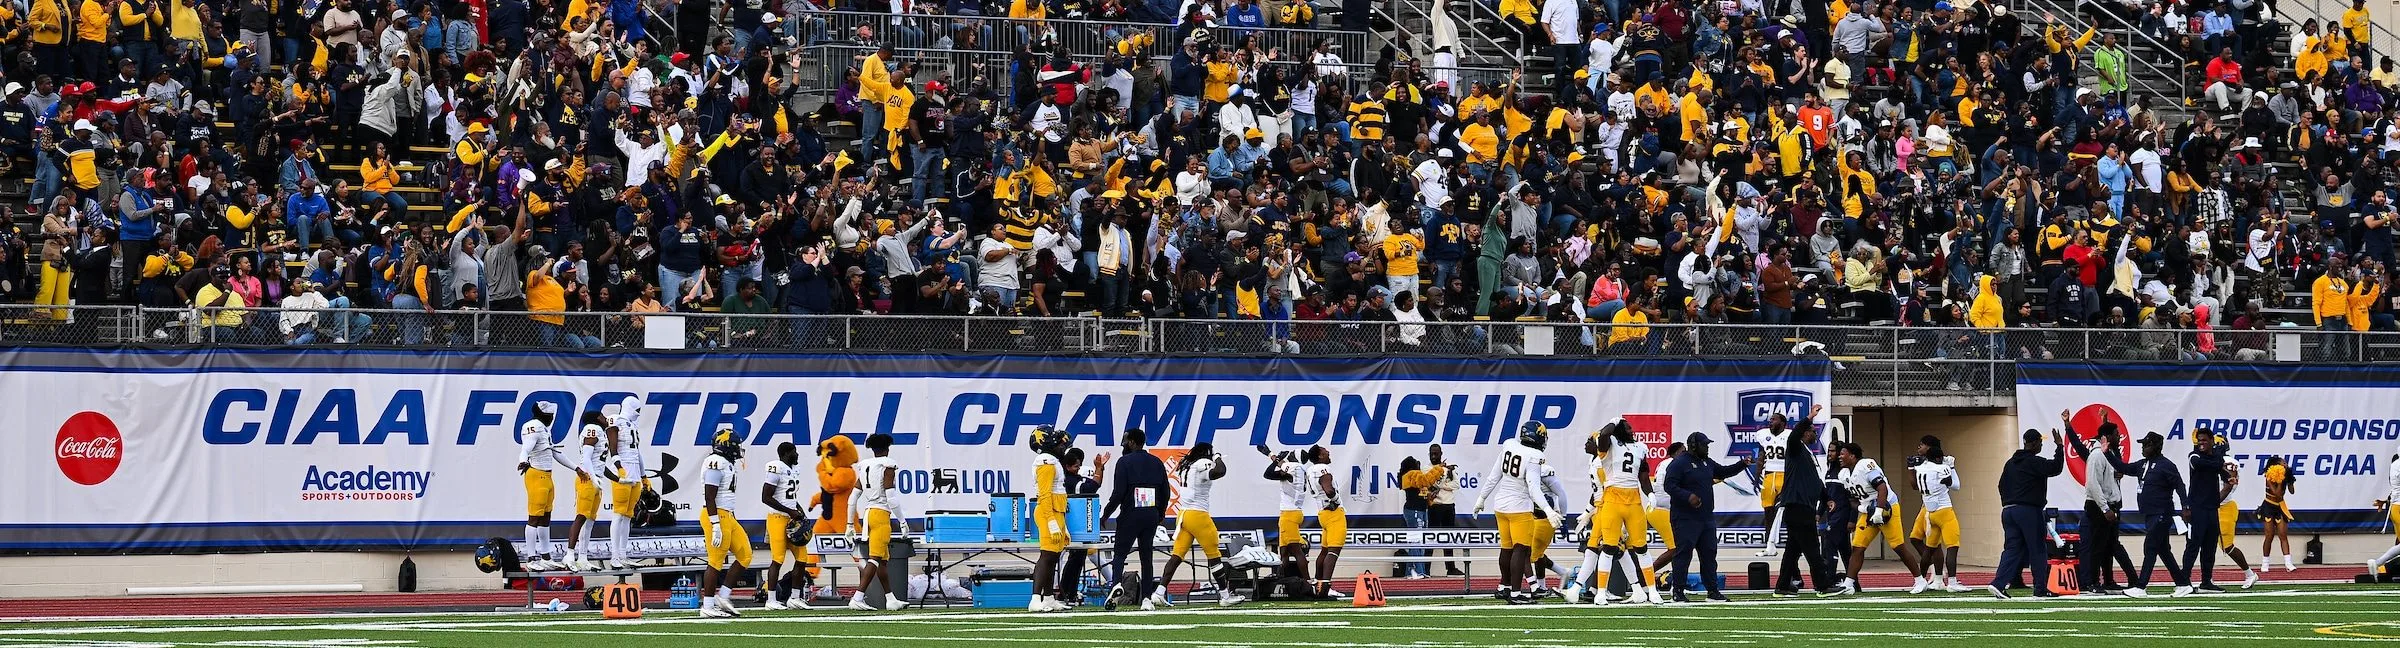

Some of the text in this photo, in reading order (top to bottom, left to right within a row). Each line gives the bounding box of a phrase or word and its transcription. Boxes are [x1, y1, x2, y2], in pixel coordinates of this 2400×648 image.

[1812, 113, 1823, 131] 9
[202, 388, 430, 446] CIAA
[943, 392, 1577, 448] CHAMPIONSHIP
[1753, 401, 1800, 422] CIAA
[526, 426, 536, 434] 15
[2166, 418, 2185, 440] A
[2194, 418, 2287, 440] PROUD
[57, 436, 120, 460] Coca-Cola
[1646, 447, 1667, 459] RGO
[708, 461, 718, 469] 44
[1502, 450, 1522, 478] 88
[1622, 451, 1634, 473] 2
[1866, 462, 1876, 471] 90
[2255, 454, 2308, 476] TE
[2314, 454, 2376, 476] CIAA
[301, 465, 430, 499] Academy
[865, 465, 872, 489] 1
[898, 469, 1010, 494] OD LION
[1918, 473, 1931, 495] 11
[301, 492, 414, 501] SPORTS+OUTDOORS
[1300, 532, 1501, 545] POERADE POWER
[1364, 577, 1384, 602] 50
[2058, 567, 2077, 591] 40
[608, 586, 640, 613] 40
